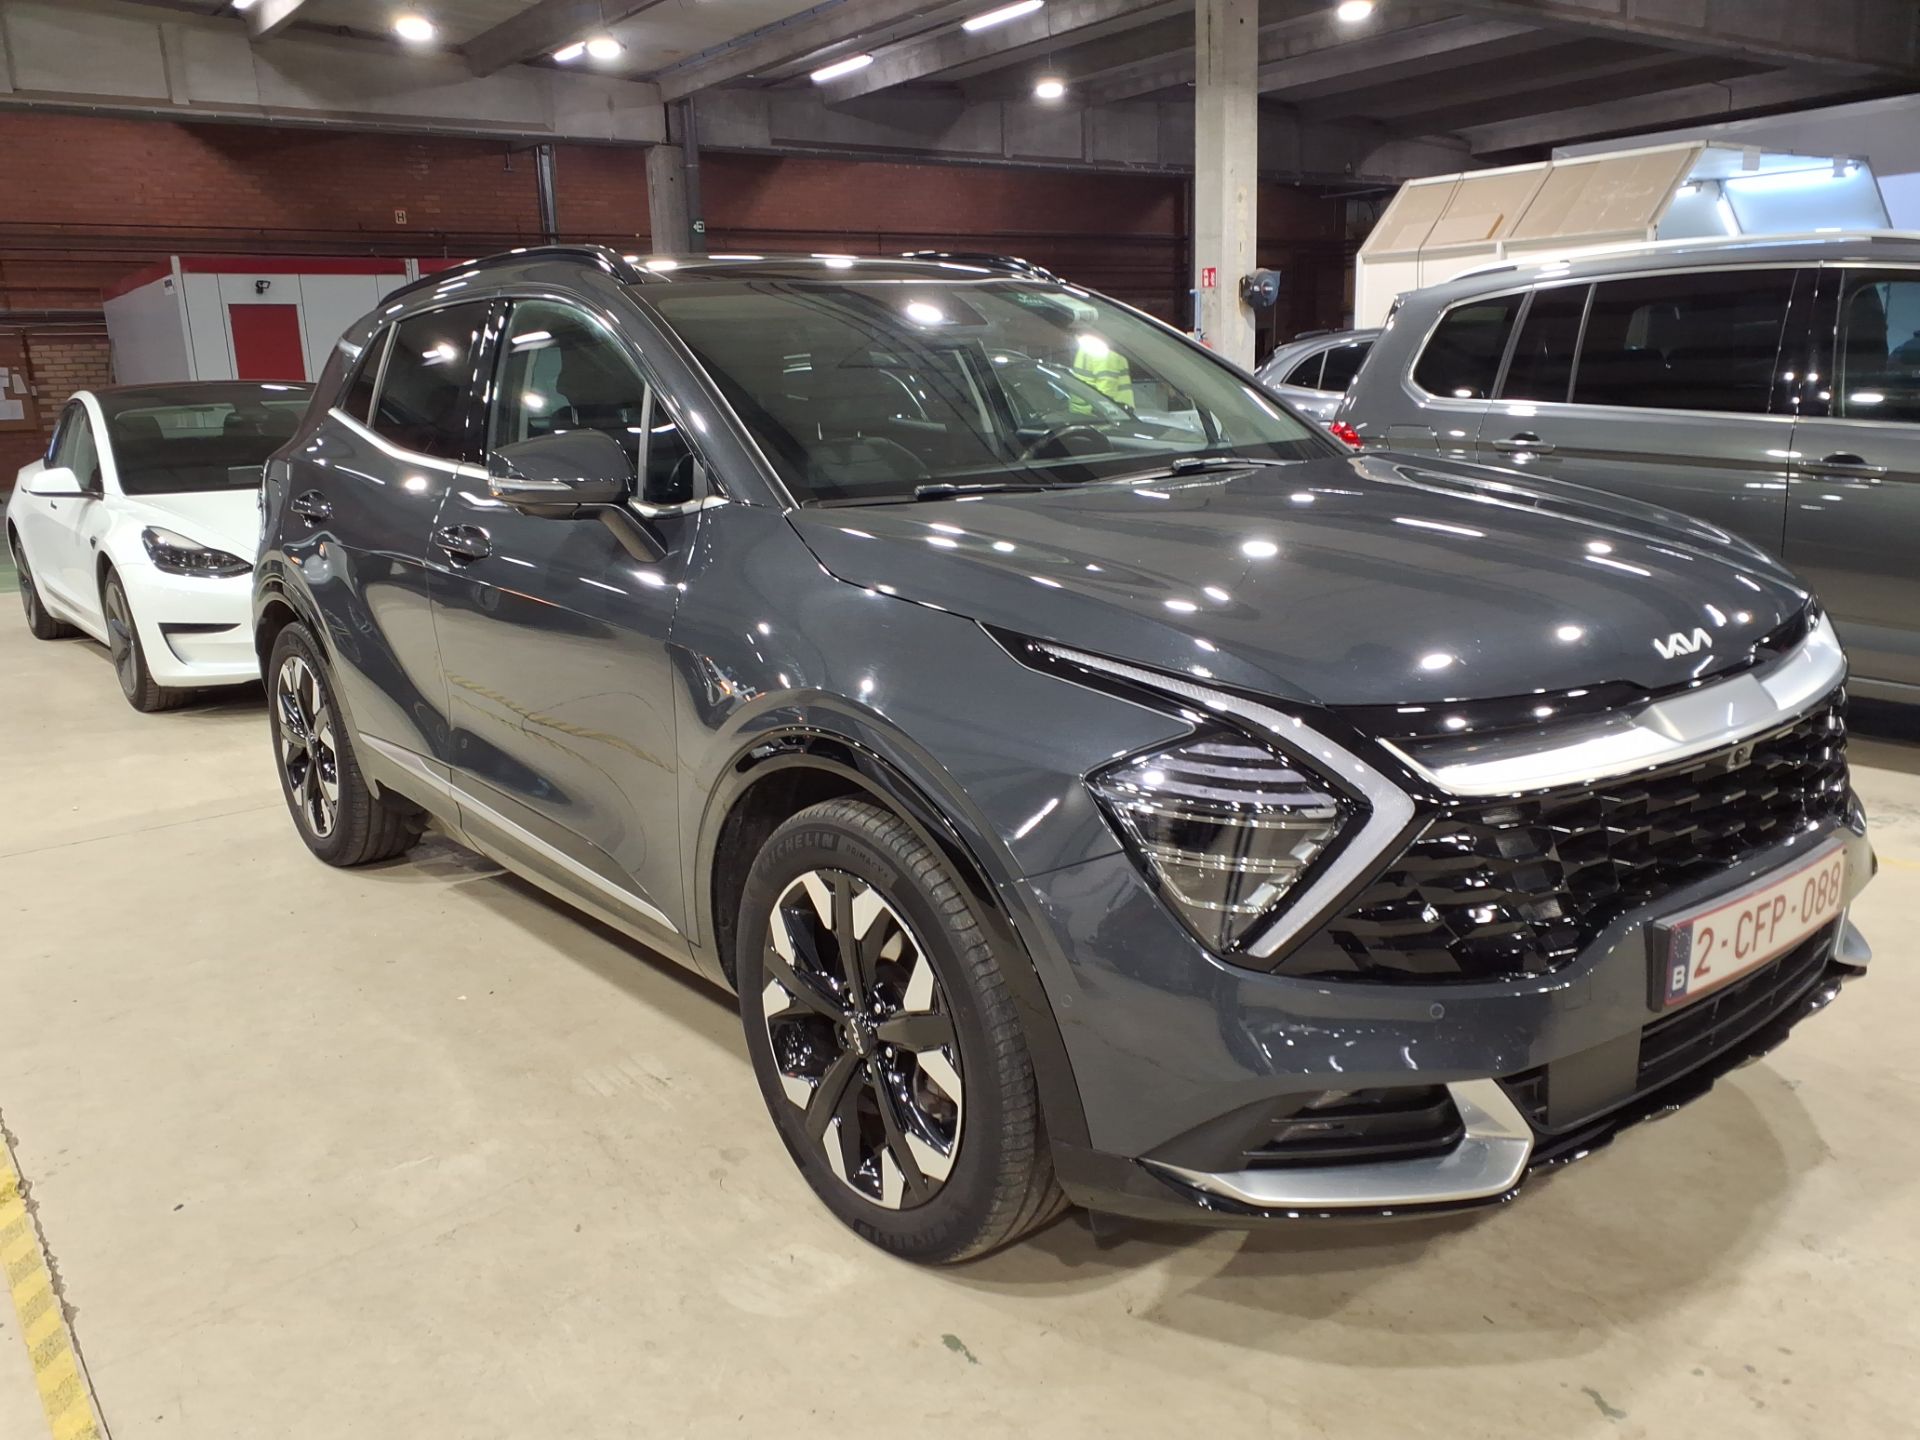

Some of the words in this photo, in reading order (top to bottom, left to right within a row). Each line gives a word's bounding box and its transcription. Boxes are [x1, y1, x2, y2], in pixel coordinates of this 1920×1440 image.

[1653, 627, 1713, 659] KIA
[1693, 861, 1841, 979] 2-CFP-088
[1672, 965, 1686, 991] B
